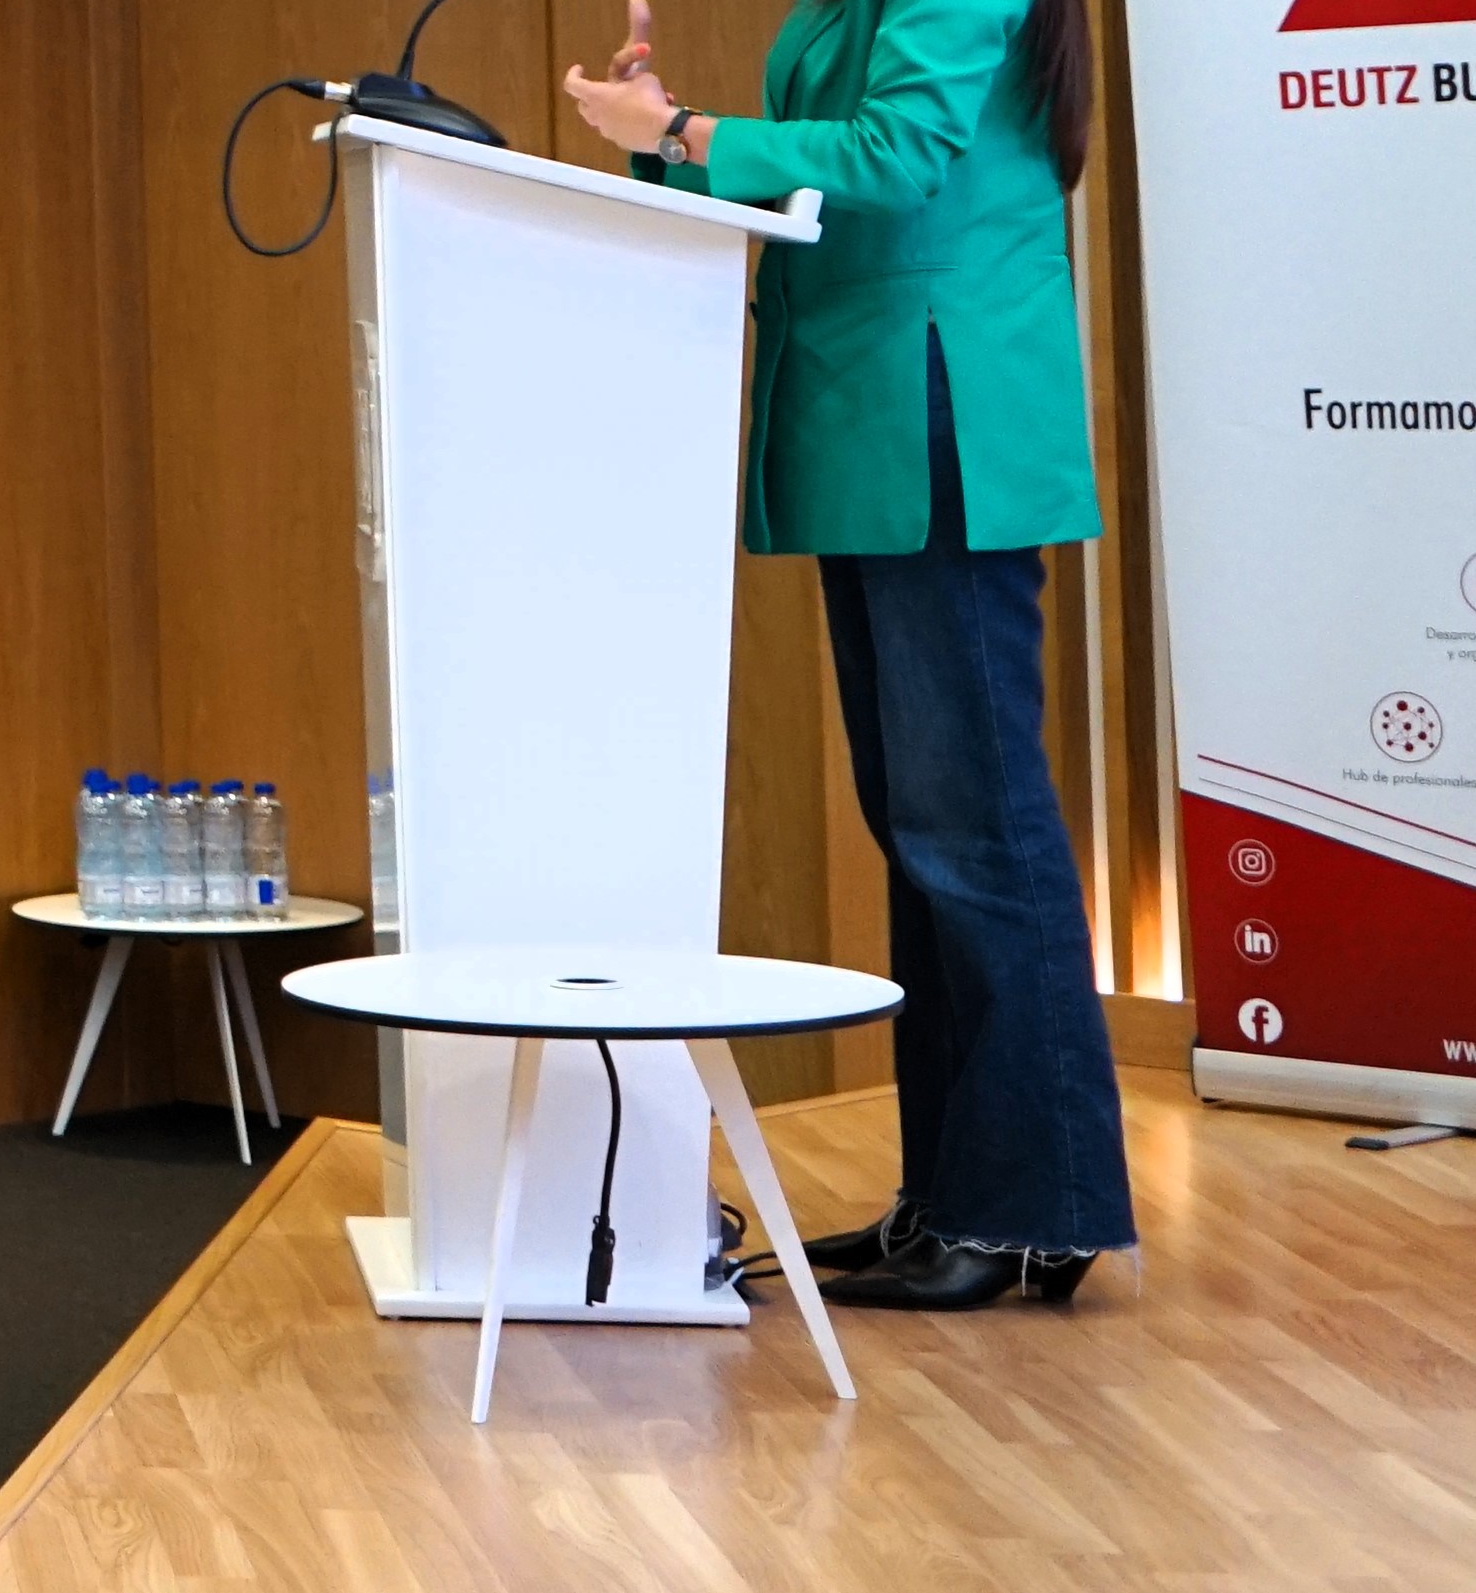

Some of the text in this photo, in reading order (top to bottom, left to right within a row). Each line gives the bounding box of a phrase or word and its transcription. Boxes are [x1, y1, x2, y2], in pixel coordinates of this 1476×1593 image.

[1279, 64, 1420, 110] DEUTZ
[1304, 388, 1476, 430] Formamo
[1342, 768, 1369, 782] Hub
[1373, 769, 1389, 784] de
[1244, 924, 1272, 954] in
